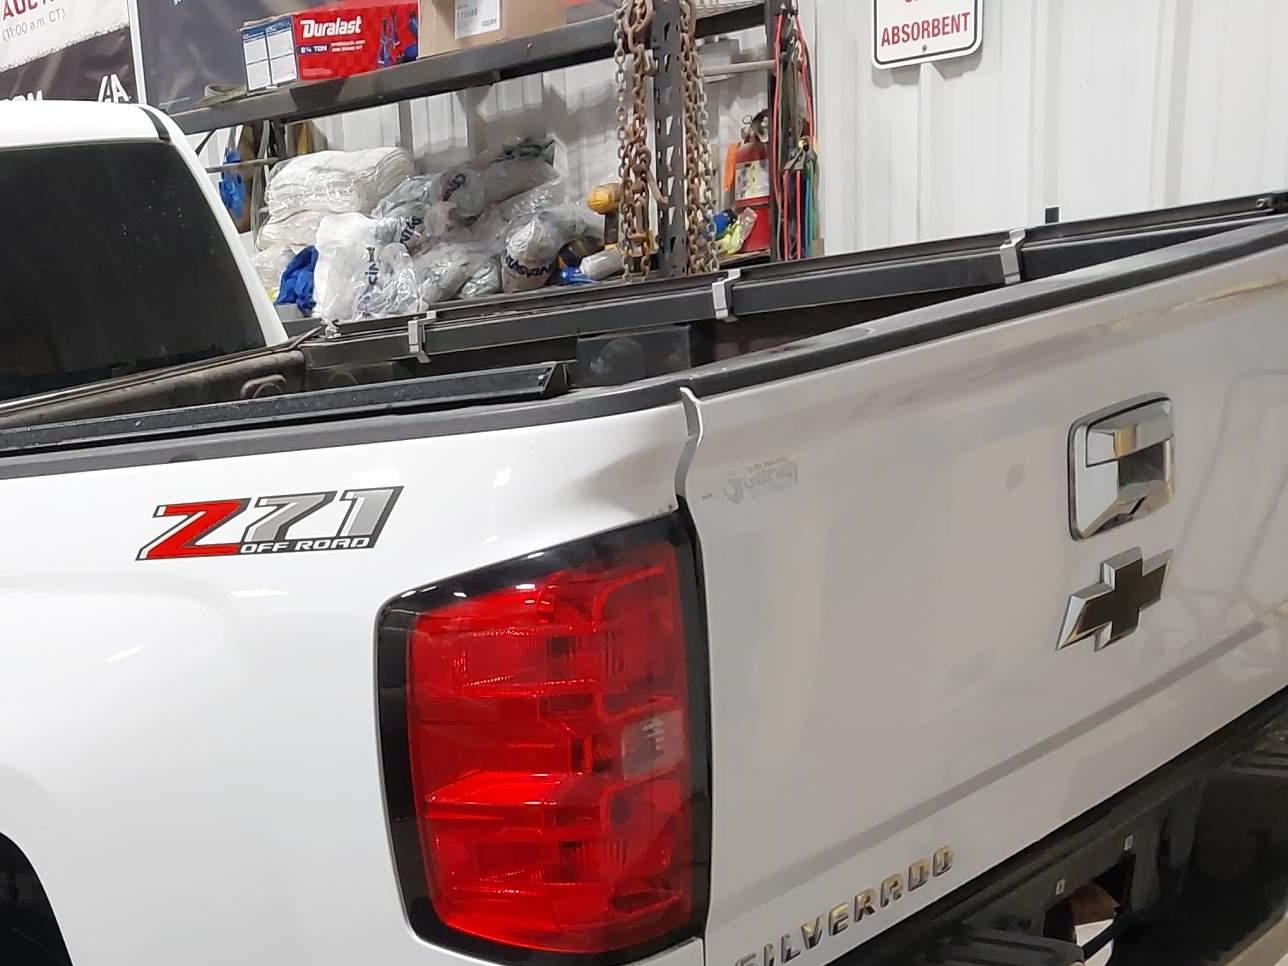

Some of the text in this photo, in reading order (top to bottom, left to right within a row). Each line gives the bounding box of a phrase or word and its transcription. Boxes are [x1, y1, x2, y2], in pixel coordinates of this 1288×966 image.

[300, 15, 362, 39] Duralast
[881, 11, 971, 47] ABSORBENT
[135, 485, 404, 561] Z71
[240, 537, 370, 554] OFF ROAD
